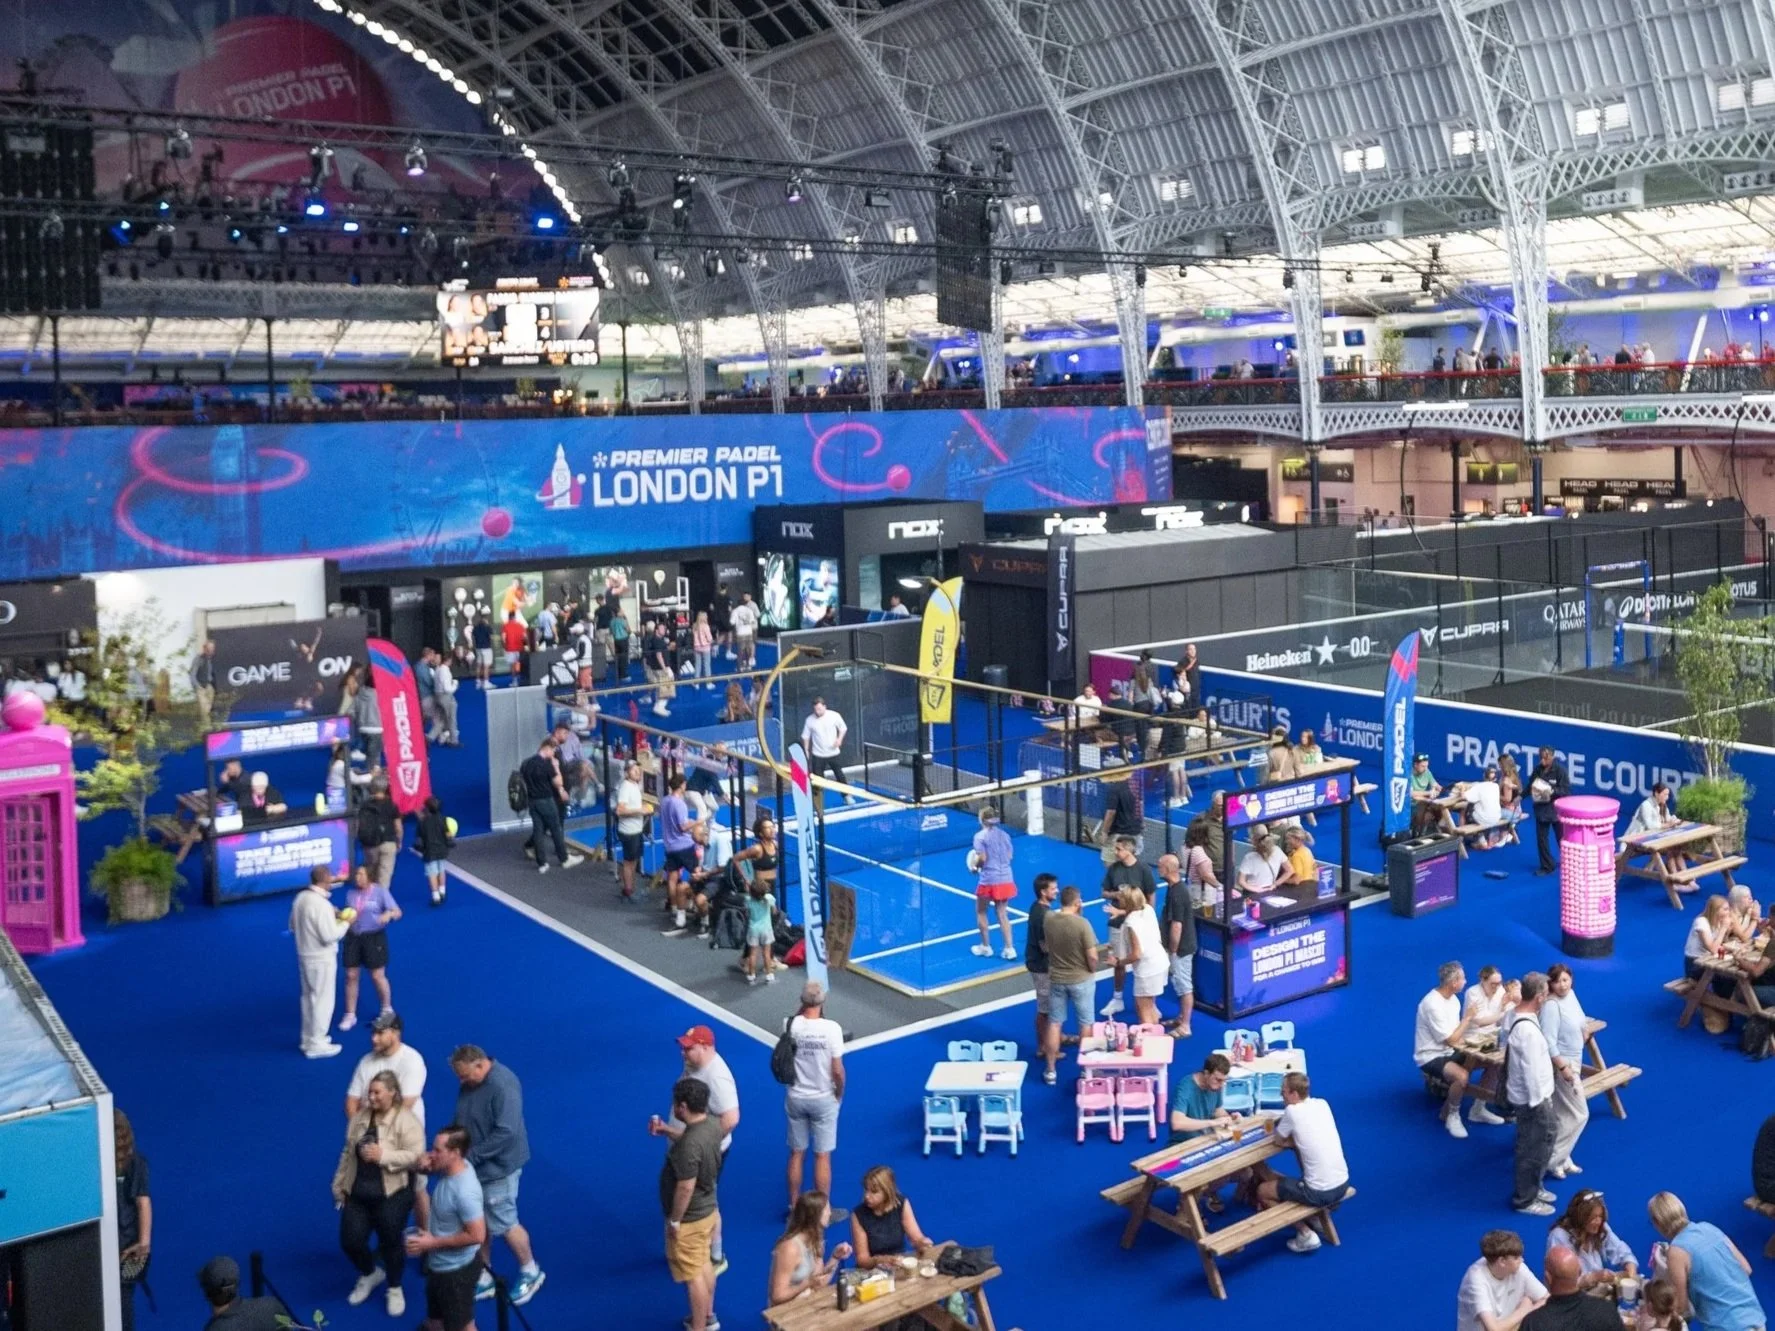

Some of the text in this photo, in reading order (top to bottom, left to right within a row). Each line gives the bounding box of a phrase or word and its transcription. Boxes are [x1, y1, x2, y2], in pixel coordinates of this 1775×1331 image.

[610, 446, 782, 468] PREMIER PADEL
[593, 465, 783, 507] LONDON P1
[1564, 480, 1597, 488] HEAD
[1604, 480, 1638, 489] HEAD
[1646, 481, 1675, 489] HEA
[1059, 546, 1068, 629] CUPRA
[1544, 600, 1585, 623] QATAR
[1440, 619, 1509, 641] CUPRA
[228, 656, 353, 687] GAME ON
[1246, 649, 1312, 672] Heineken
[392, 691, 415, 760] PADEL
[1345, 719, 1383, 731] PREMIER
[1394, 697, 1406, 774] PADEL
[1252, 930, 1326, 961] DESIGN THE
